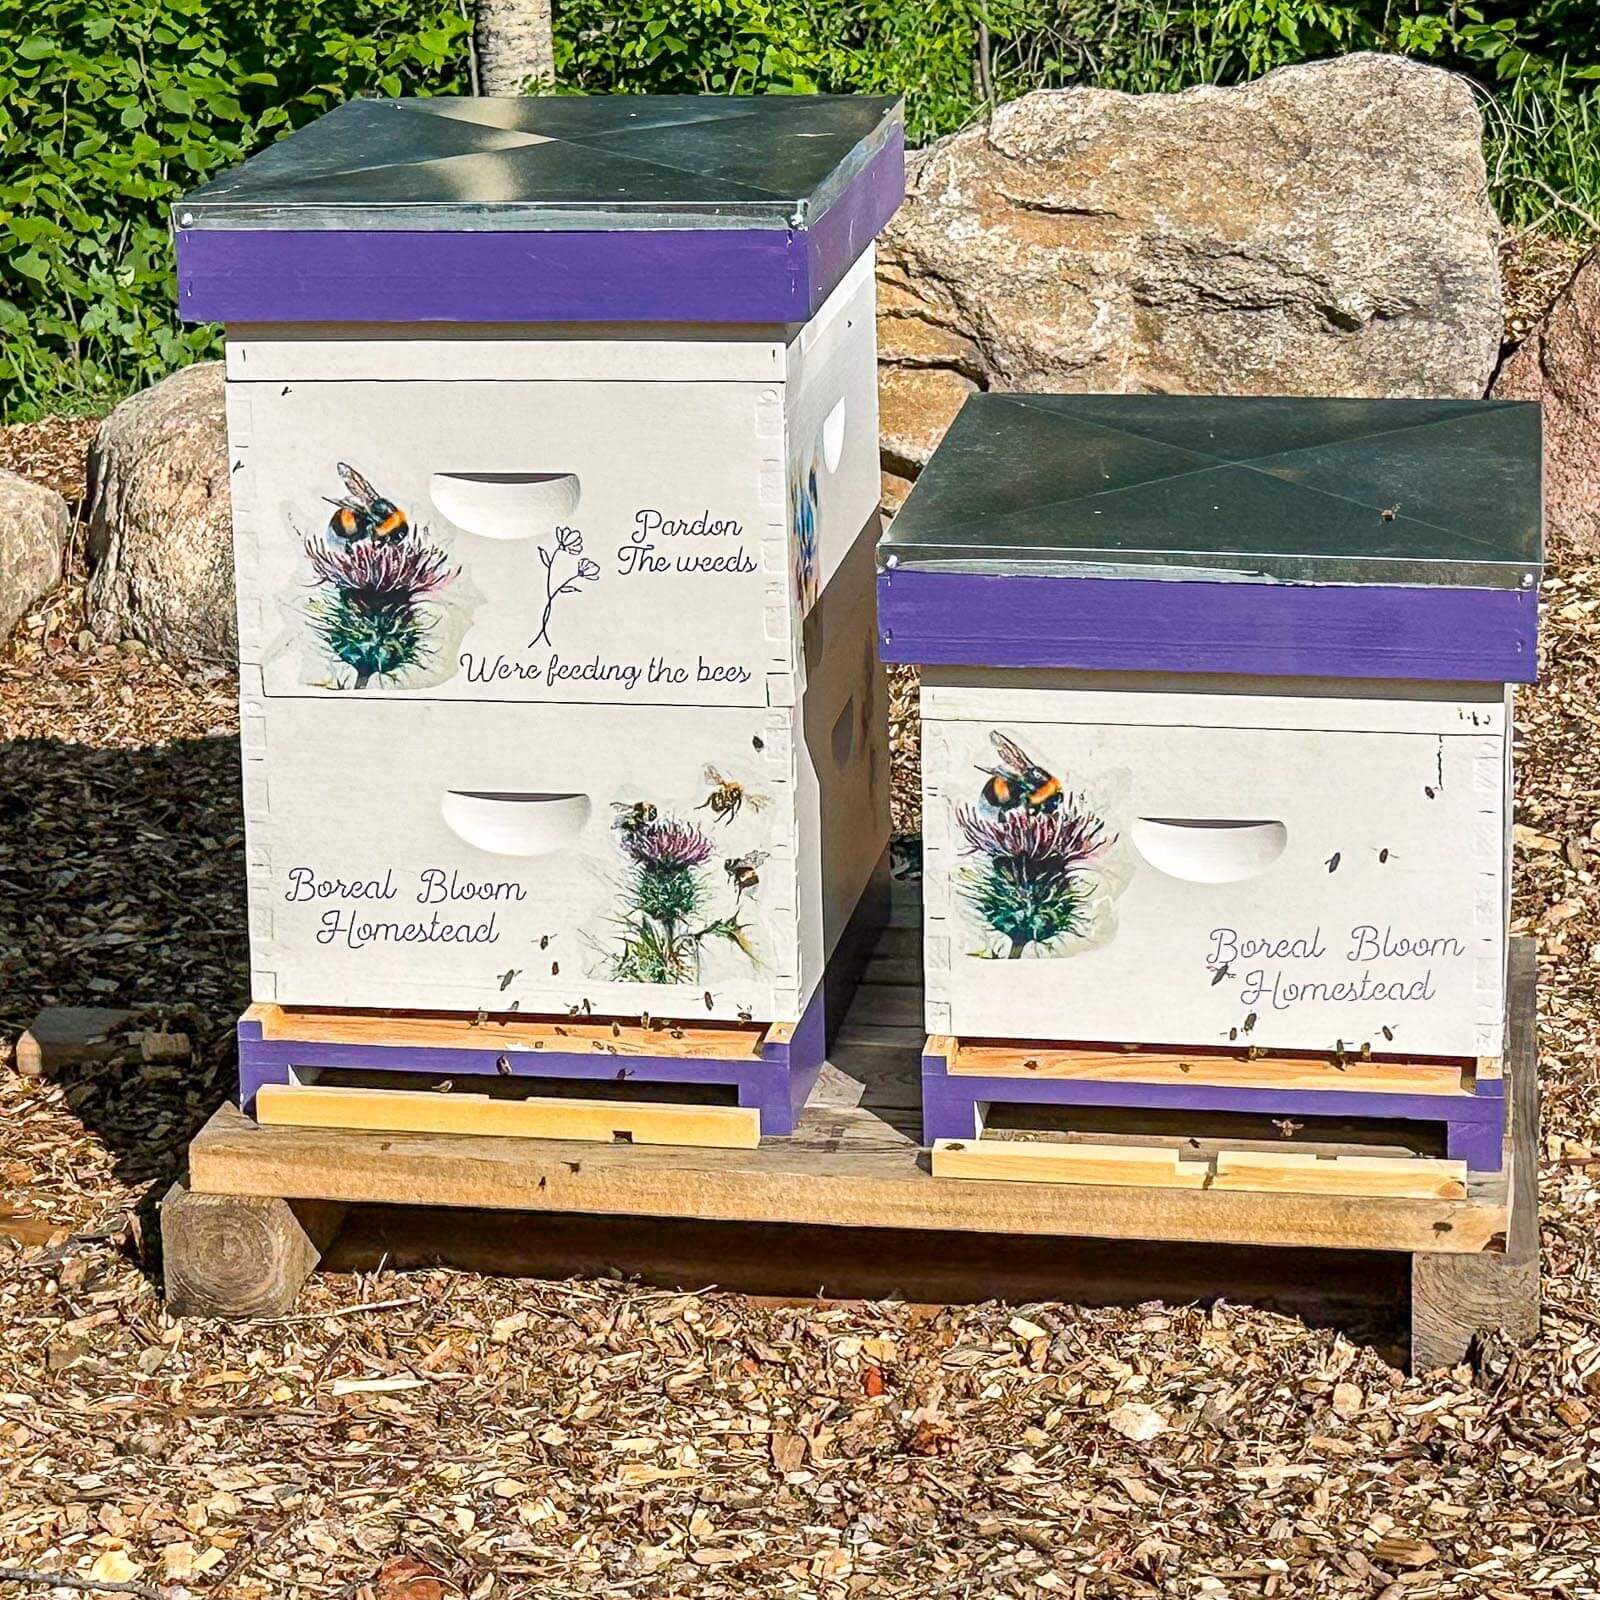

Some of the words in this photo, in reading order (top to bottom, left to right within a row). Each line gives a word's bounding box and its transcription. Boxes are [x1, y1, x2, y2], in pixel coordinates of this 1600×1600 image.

[631, 509, 743, 544] Pardon
[617, 545, 671, 575] The
[676, 546, 758, 574] weeds
[546, 654, 642, 690] feeding
[648, 656, 689, 683] the
[696, 656, 751, 683] bees
[284, 867, 398, 902] Boreal
[416, 868, 527, 904] Bloom
[316, 909, 500, 949] Homestead
[1206, 926, 1326, 963] Boreal
[1346, 925, 1465, 962] Bloom
[1240, 969, 1436, 1010] Homestead
